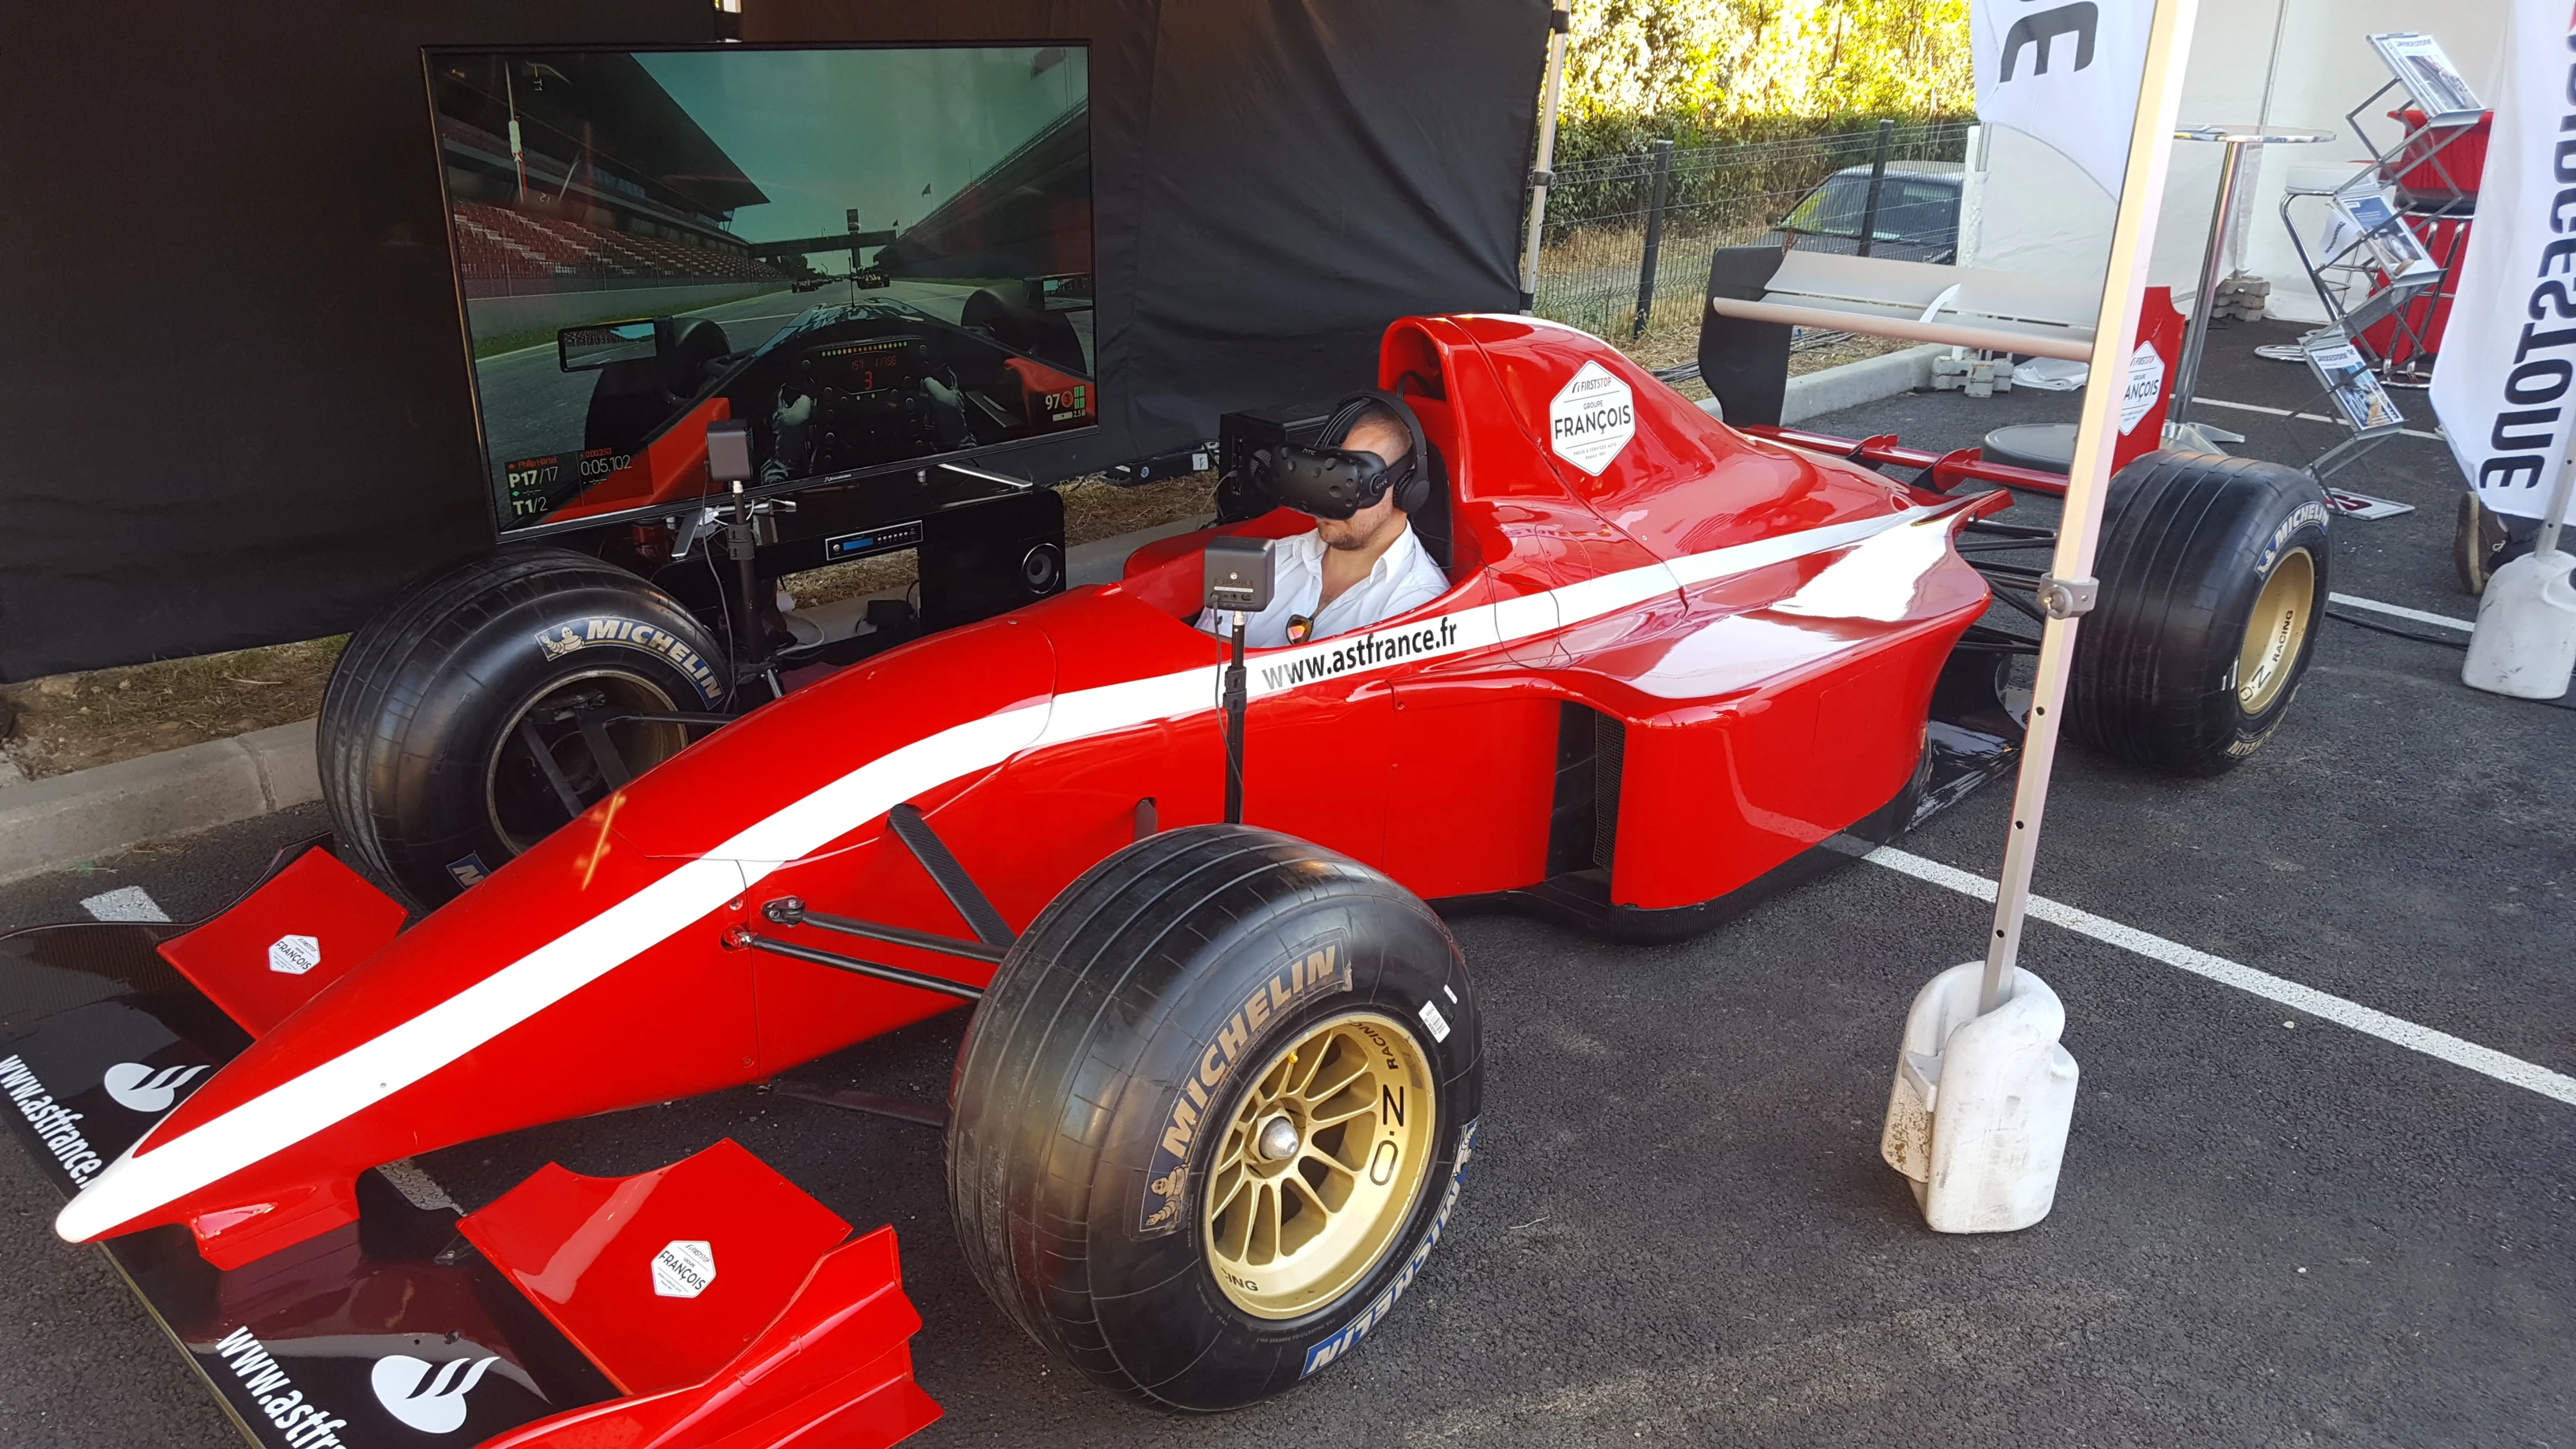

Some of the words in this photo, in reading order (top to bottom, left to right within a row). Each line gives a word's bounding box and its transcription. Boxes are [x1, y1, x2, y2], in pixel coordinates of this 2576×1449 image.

[1999, 0, 2099, 84] E
[865, 371, 873, 391] 3
[1581, 376, 1612, 392] FIRSTSTOP
[2123, 380, 2159, 402] ANÇOIS
[1045, 393, 1061, 410] 97
[1583, 400, 1604, 410] GROUPE
[1554, 404, 1631, 440] FRANÇOIS
[509, 466, 559, 489] P17/17
[580, 455, 632, 477] 0:05.102
[1376, 478, 1388, 490] VIVE
[513, 496, 549, 515] T1/2
[2275, 503, 2328, 549] MICHELIN
[1261, 616, 1458, 691] www.astfrance.fr
[2272, 610, 2293, 663] RACING
[586, 620, 722, 699] MICHELIN
[275, 941, 312, 970] FRANÇOIS
[1162, 945, 1335, 1159] MICHELIN
[1349, 1022, 1399, 1070] RACING
[658, 1250, 706, 1290] FRANÇOIS
[1221, 1267, 1259, 1291] ING
[1306, 1180, 1460, 1374] MICHELIN
[215, 1326, 347, 1449] www.astfr
